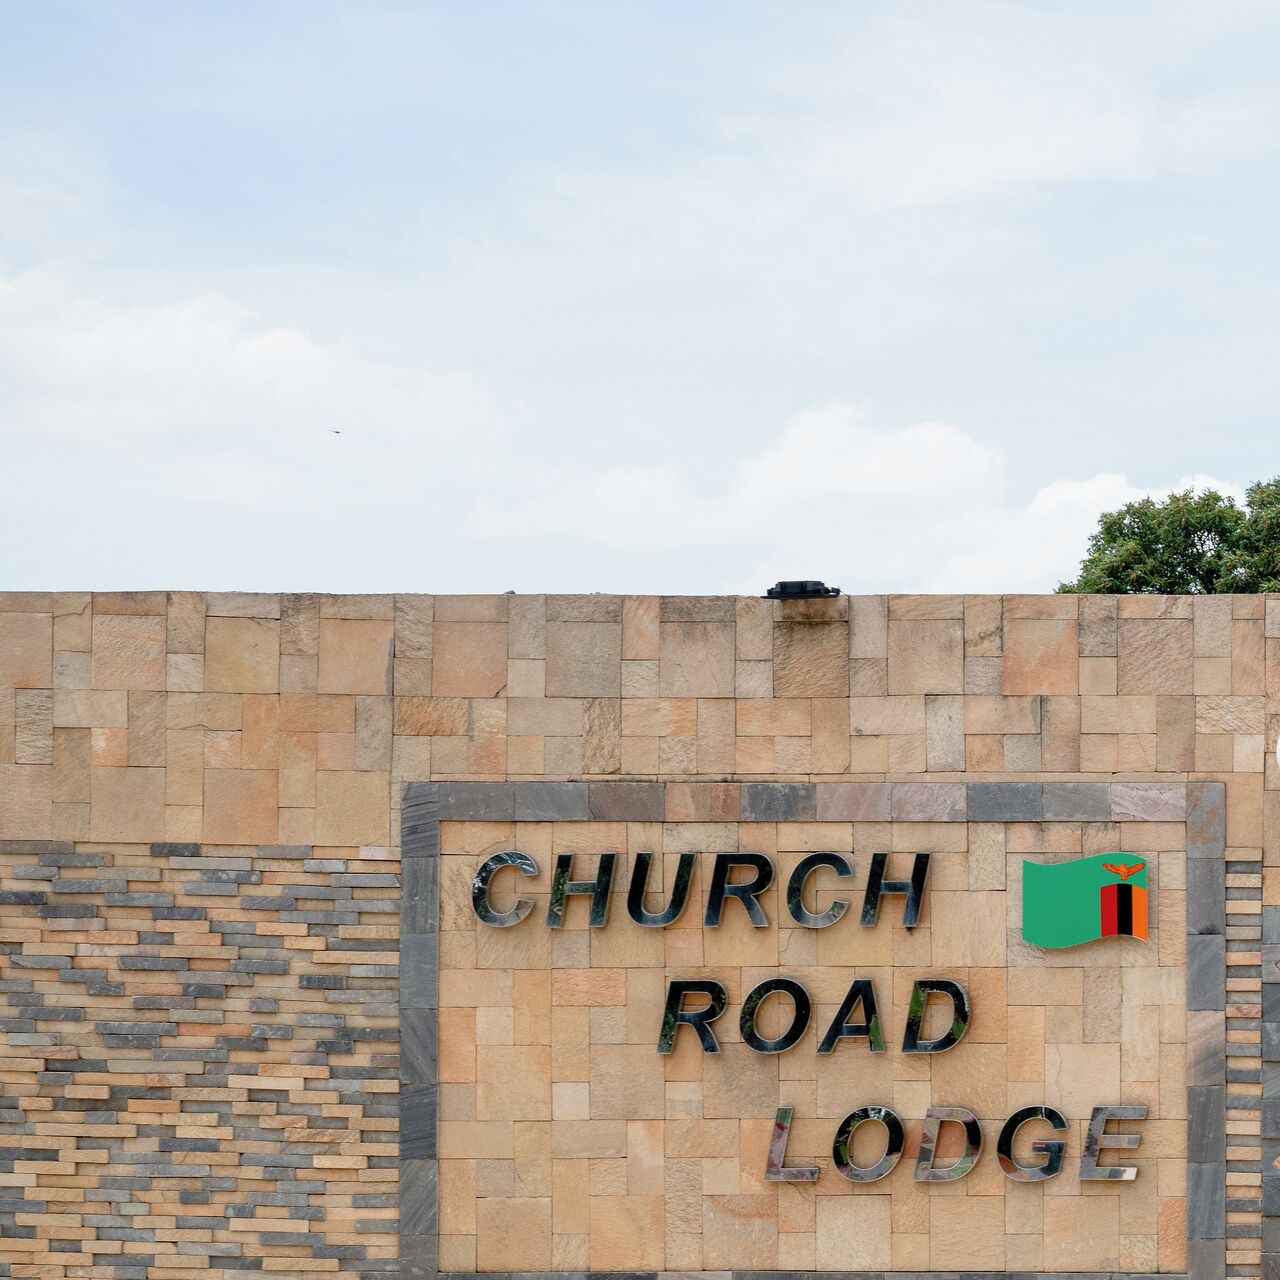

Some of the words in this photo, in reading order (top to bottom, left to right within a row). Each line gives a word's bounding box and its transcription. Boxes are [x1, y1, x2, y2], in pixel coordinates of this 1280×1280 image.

[472, 851, 932, 929] CHURCH
[657, 978, 971, 1055] ROAD
[764, 1105, 1149, 1183] LODGE
